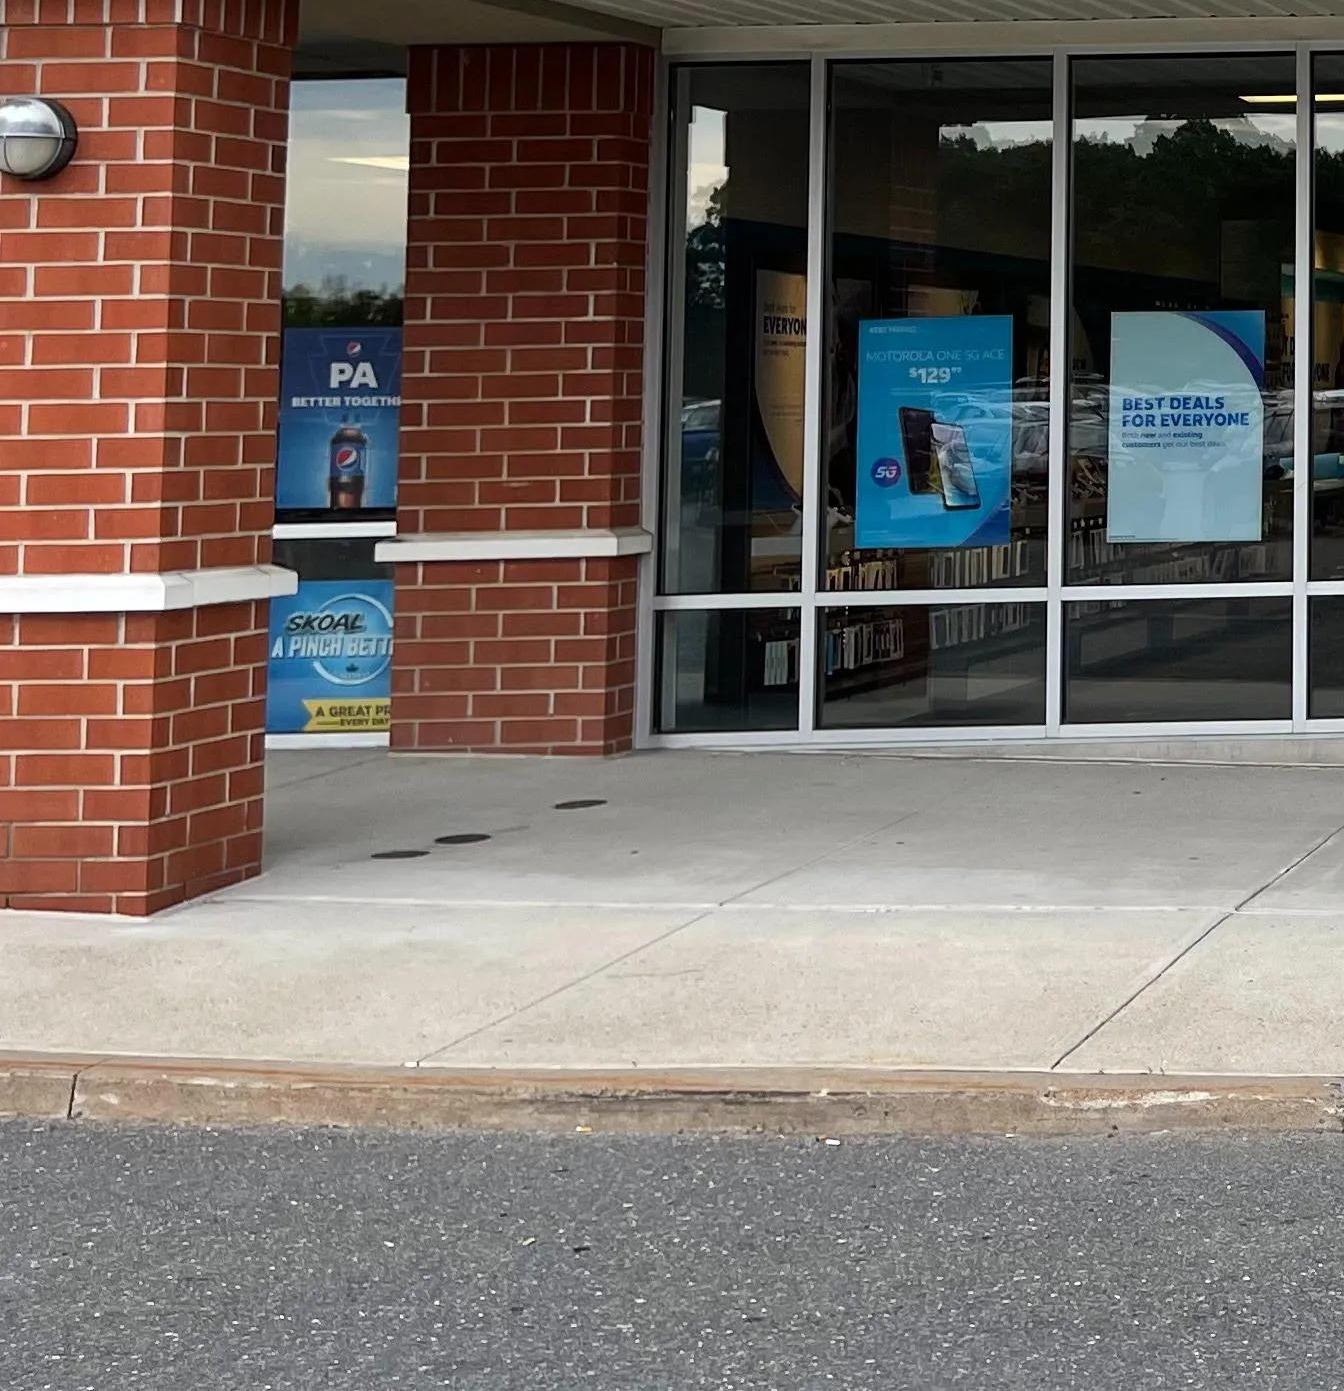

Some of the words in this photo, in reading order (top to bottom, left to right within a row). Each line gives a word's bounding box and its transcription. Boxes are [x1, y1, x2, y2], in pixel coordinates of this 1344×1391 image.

[763, 316, 807, 335] EVERYON
[866, 350, 933, 362] MOTOROLA
[936, 350, 961, 360] ONE
[983, 349, 1005, 359] ACE
[329, 362, 378, 388] PA
[291, 397, 341, 408] BETTER
[1122, 397, 1165, 411] BEST
[1169, 396, 1224, 410] DEALS
[1122, 413, 1156, 427] FOR
[1160, 412, 1249, 427] EVERYONE
[1173, 431, 1202, 440] existing
[875, 466, 897, 478] 5G
[287, 613, 364, 632] SKOAL
[271, 636, 283, 658] A
[288, 635, 342, 657] PINCH
[316, 706, 325, 717] A
[329, 705, 371, 717] GREAT
[340, 718, 369, 727] EVERY
